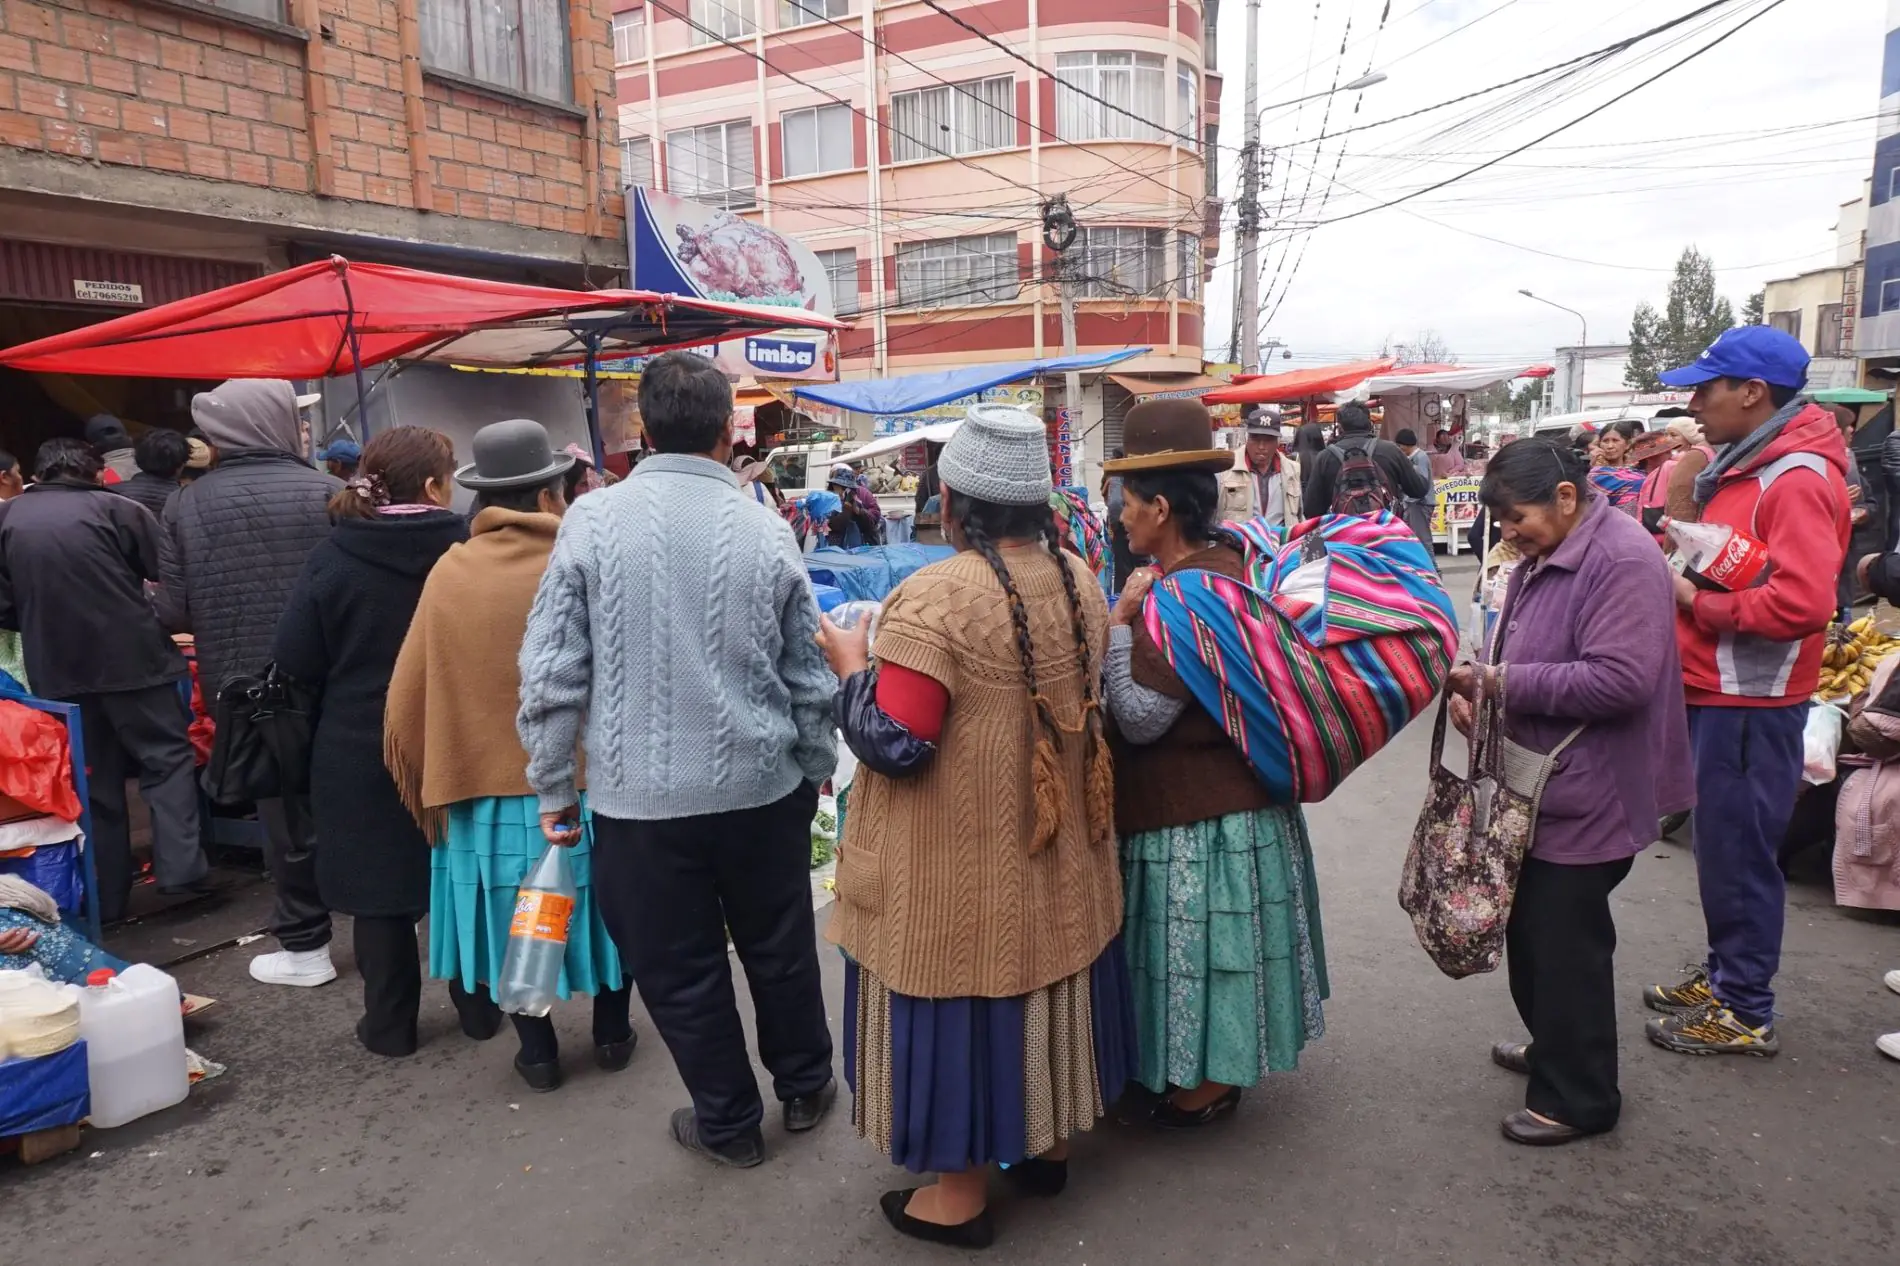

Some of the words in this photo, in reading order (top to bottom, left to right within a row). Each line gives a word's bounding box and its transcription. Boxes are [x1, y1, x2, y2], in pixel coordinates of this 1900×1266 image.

[85, 282, 131, 291] PEDIDOS
[1844, 270, 1857, 357] FARMACI
[749, 341, 812, 365] imba
